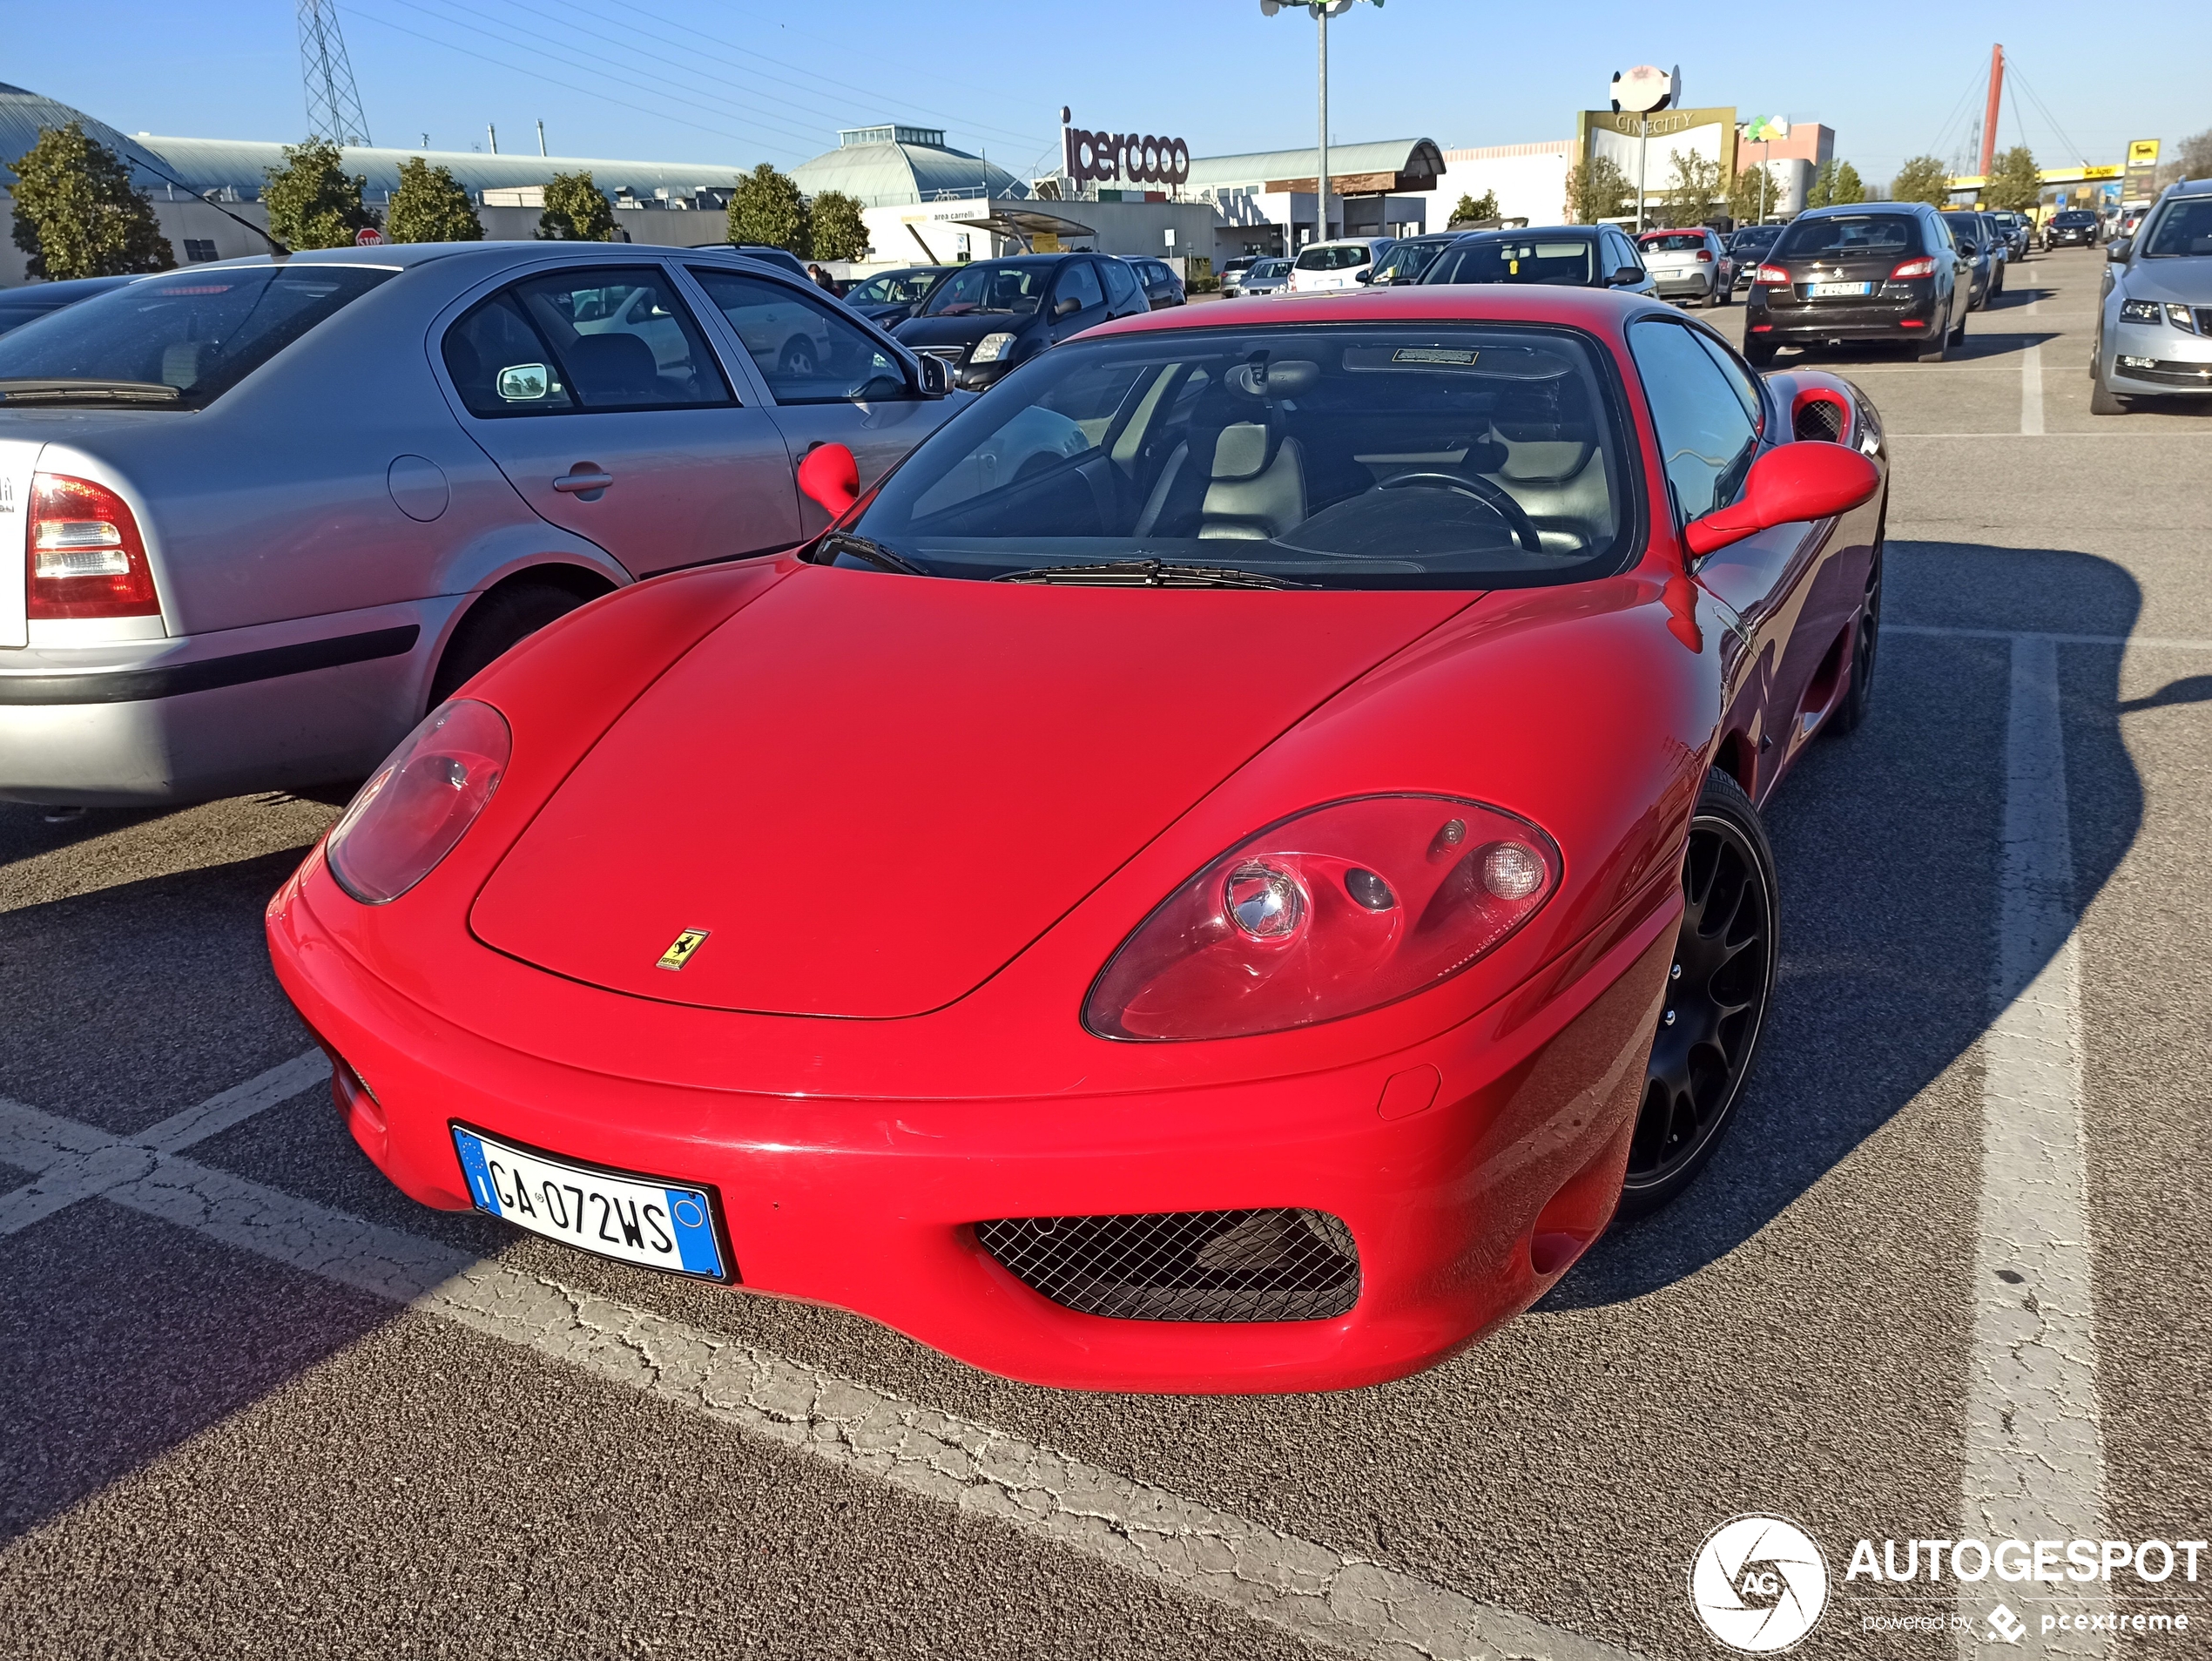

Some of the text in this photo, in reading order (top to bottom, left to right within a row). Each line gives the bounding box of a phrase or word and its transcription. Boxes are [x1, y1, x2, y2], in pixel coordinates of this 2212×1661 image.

[1615, 112, 1694, 134] CINECITY
[1059, 105, 1189, 196] ipercoop
[950, 211, 974, 219] carrelli
[358, 236, 382, 246] STOP
